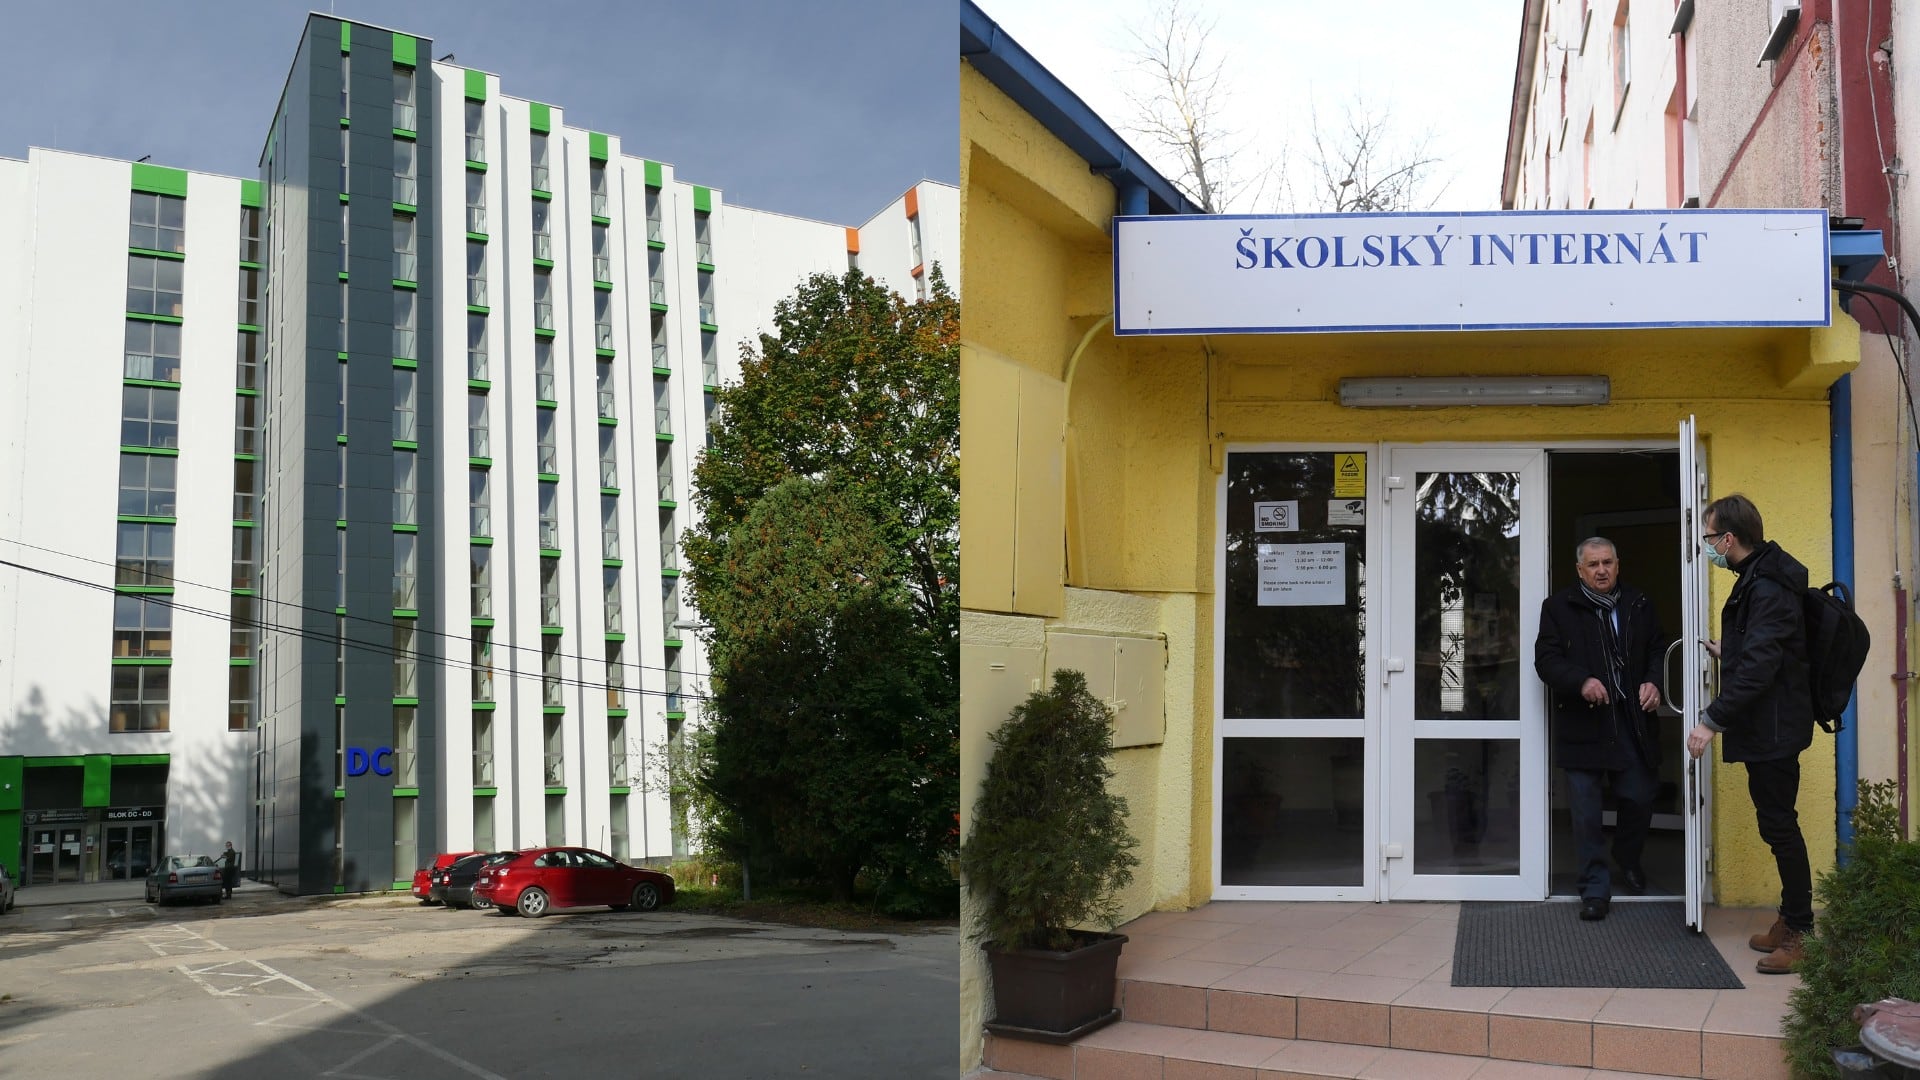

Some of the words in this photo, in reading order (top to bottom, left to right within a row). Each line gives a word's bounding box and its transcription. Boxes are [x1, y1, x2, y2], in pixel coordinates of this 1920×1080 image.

[1236, 225, 1452, 269] ŠKOLSKÝ
[1469, 223, 1708, 266] INTERNÁT
[347, 747, 392, 776] DC
